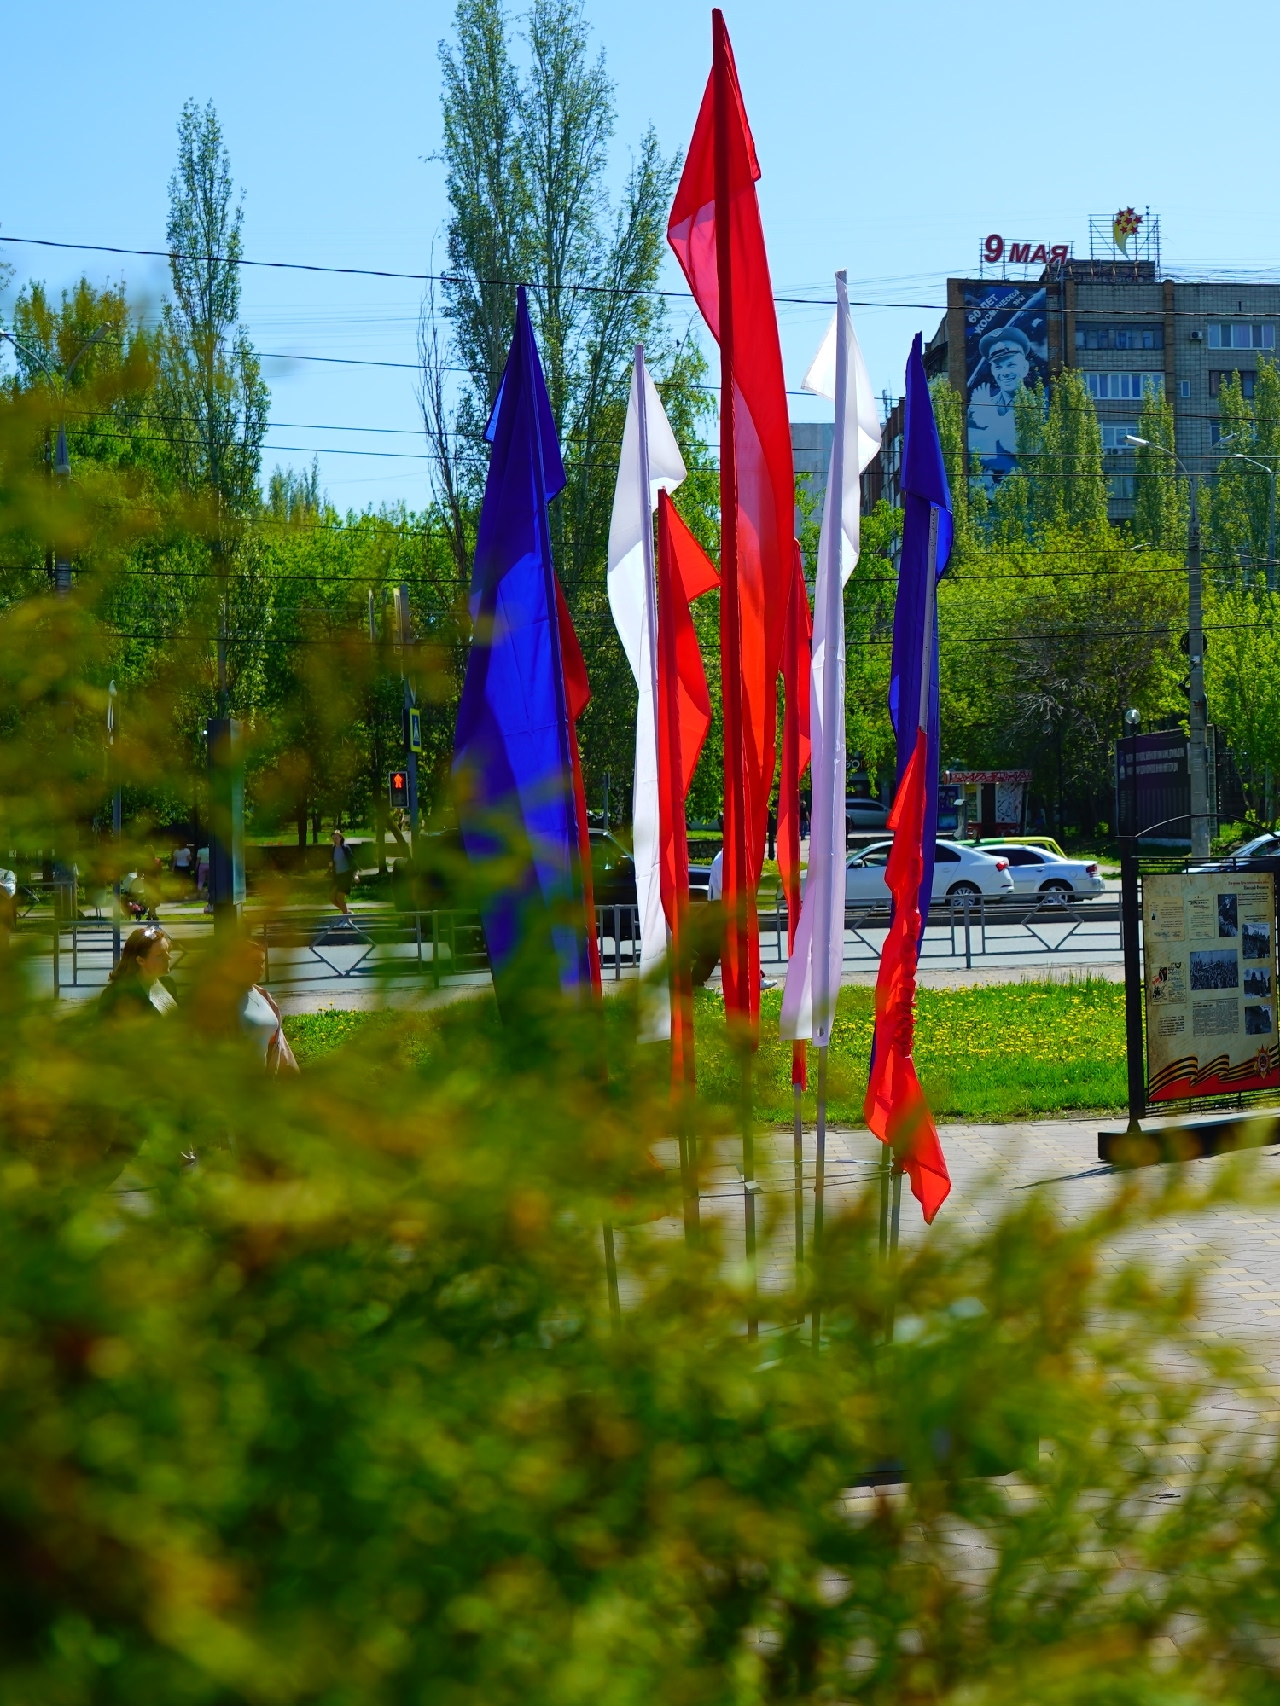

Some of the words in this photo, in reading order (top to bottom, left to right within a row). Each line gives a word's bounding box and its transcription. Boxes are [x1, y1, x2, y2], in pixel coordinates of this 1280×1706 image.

[984, 234, 1004, 264] 9
[1008, 243, 1070, 265] МАЯ
[968, 309, 981, 323] 60
[980, 293, 998, 310] ЛЕТ
